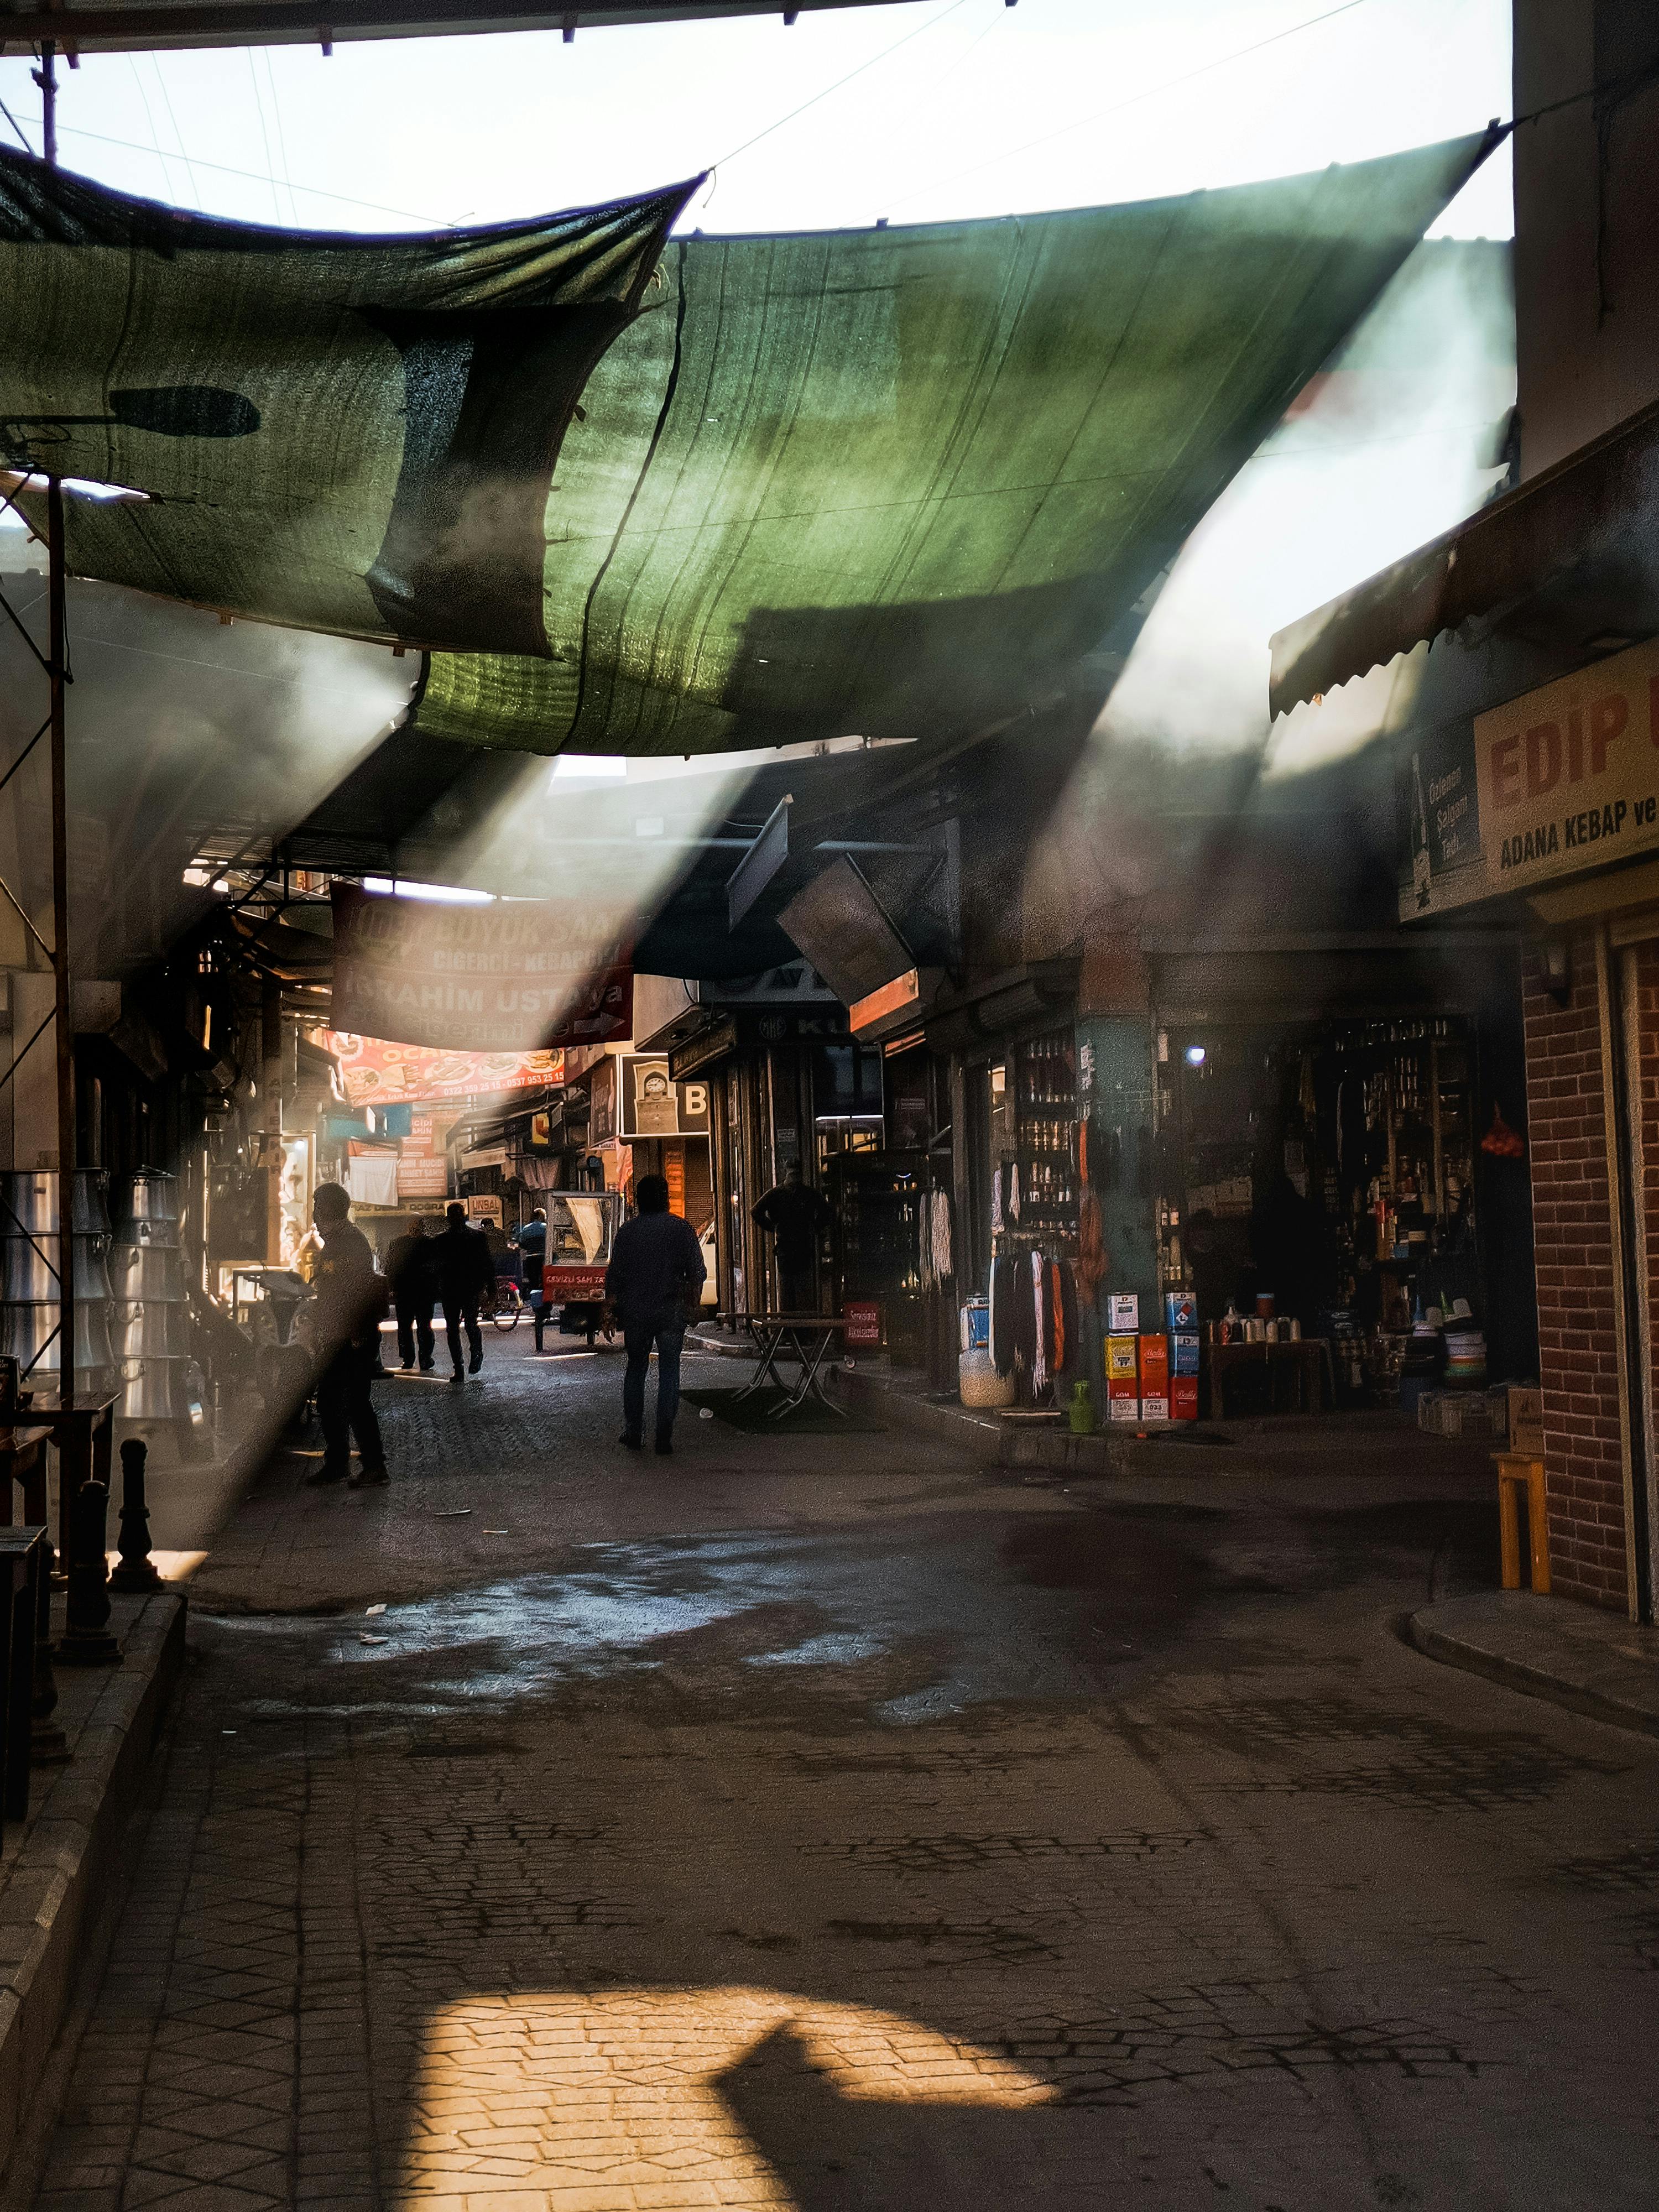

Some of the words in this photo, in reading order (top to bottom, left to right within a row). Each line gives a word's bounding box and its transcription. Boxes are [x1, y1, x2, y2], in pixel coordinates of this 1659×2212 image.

[1500, 823, 1559, 869] ADANA
[1565, 800, 1627, 848] KEBAP
[1634, 796, 1657, 826] ve
[444, 1087, 462, 1095] 0322
[507, 1077, 525, 1087] 0537
[528, 1076, 541, 1084] 953
[544, 1073, 552, 1082] 25
[555, 1071, 564, 1080] 15
